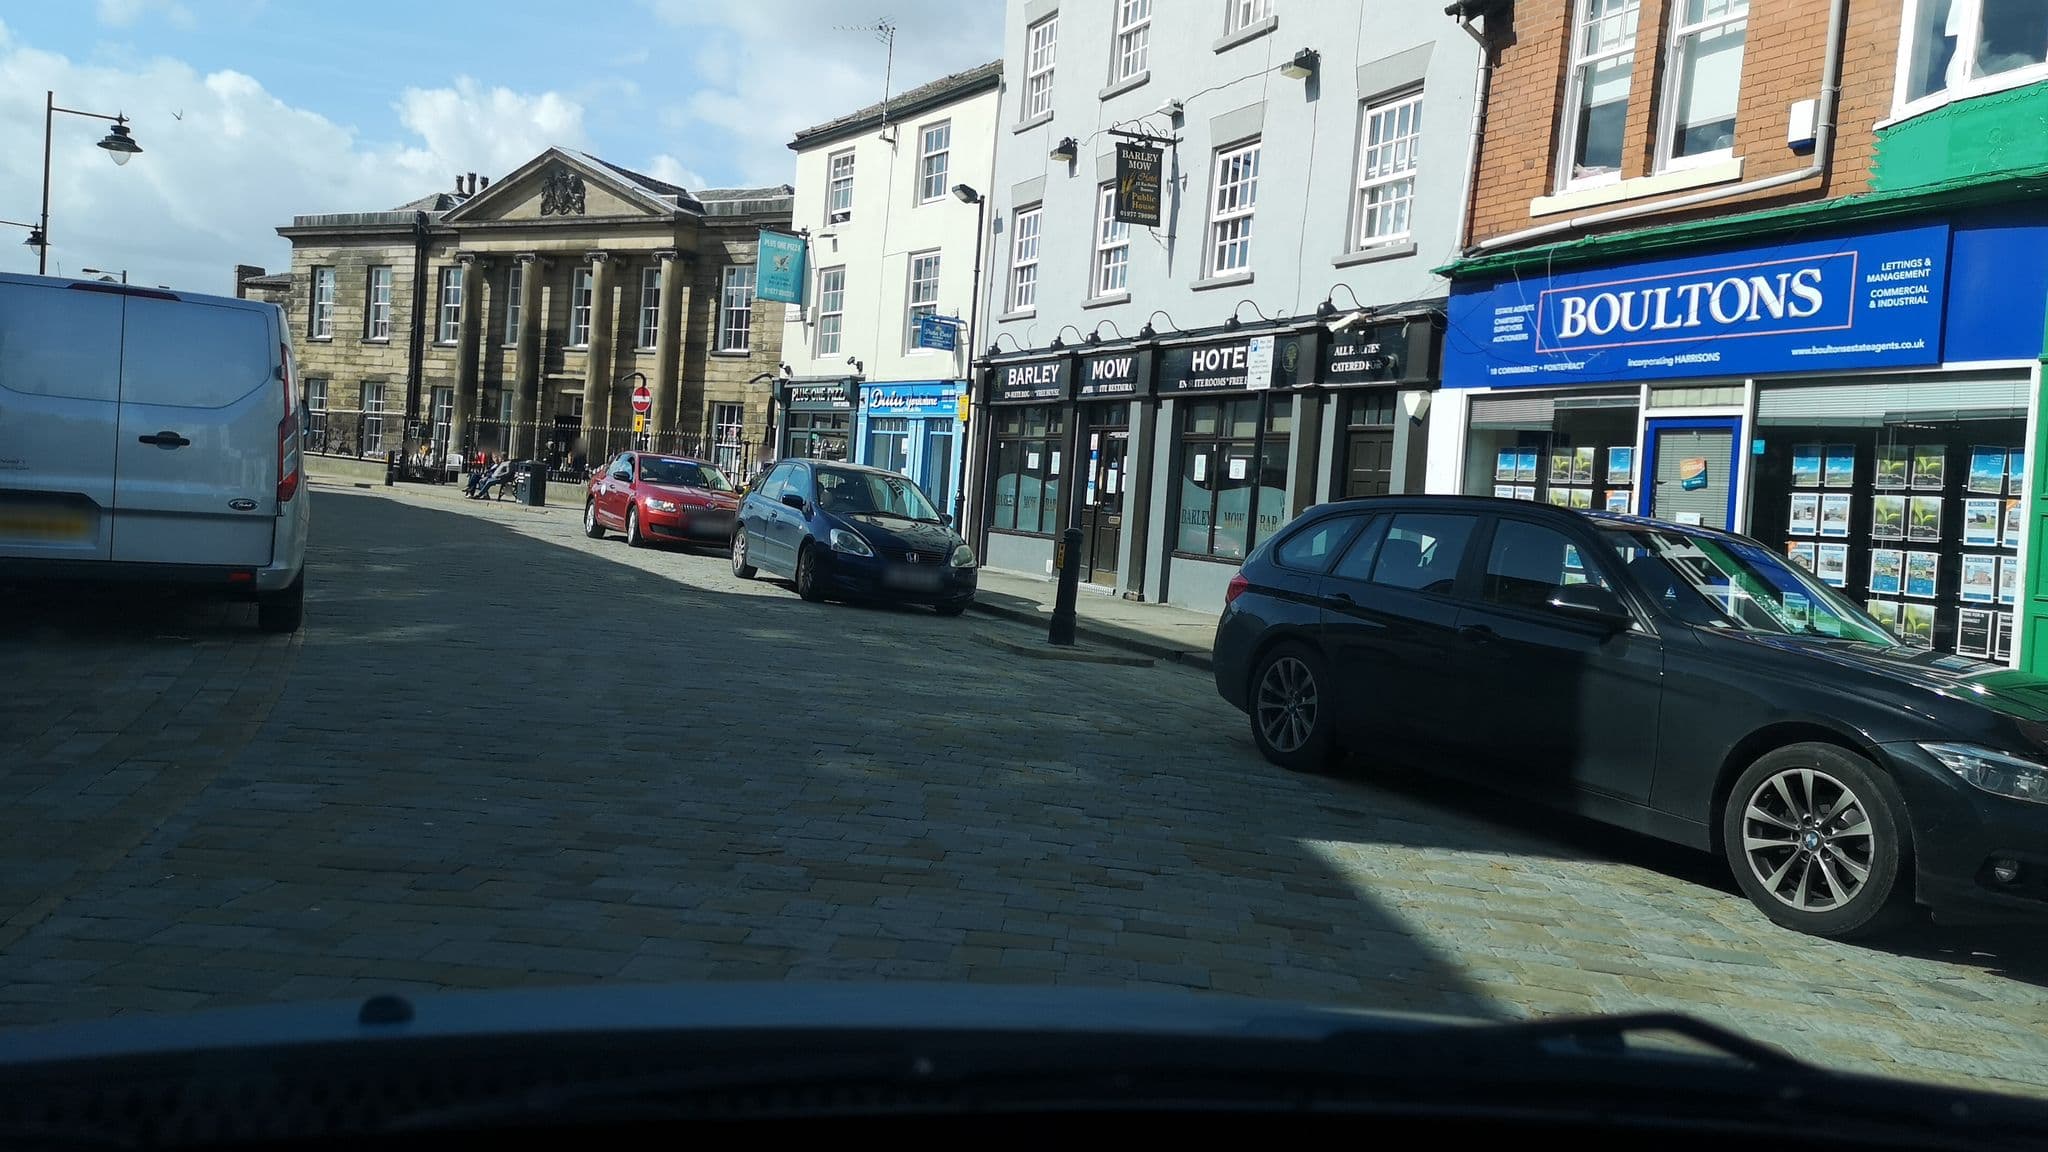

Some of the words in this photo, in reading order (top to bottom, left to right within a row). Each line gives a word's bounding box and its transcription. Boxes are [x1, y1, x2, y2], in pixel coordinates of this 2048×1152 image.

[1122, 150, 1159, 162] BARLEY
[1129, 161, 1152, 170] MOW
[1881, 260, 1922, 271] LETTINGS
[1923, 258, 1931, 267] &
[1866, 269, 1931, 282] MANAGEMENT
[1870, 285, 1929, 298] COMMERCIAL
[1559, 267, 1823, 339] BOULTONS
[1868, 300, 1876, 308] &
[1877, 295, 1928, 308] INDUSTRIAL
[1791, 339, 1925, 355] www.boultonsestateagents.co.uk
[1674, 352, 1721, 363] HARRISONS
[1008, 364, 1060, 385] BARLEY
[1092, 358, 1131, 380] MOW
[1331, 360, 1365, 372] CATERED
